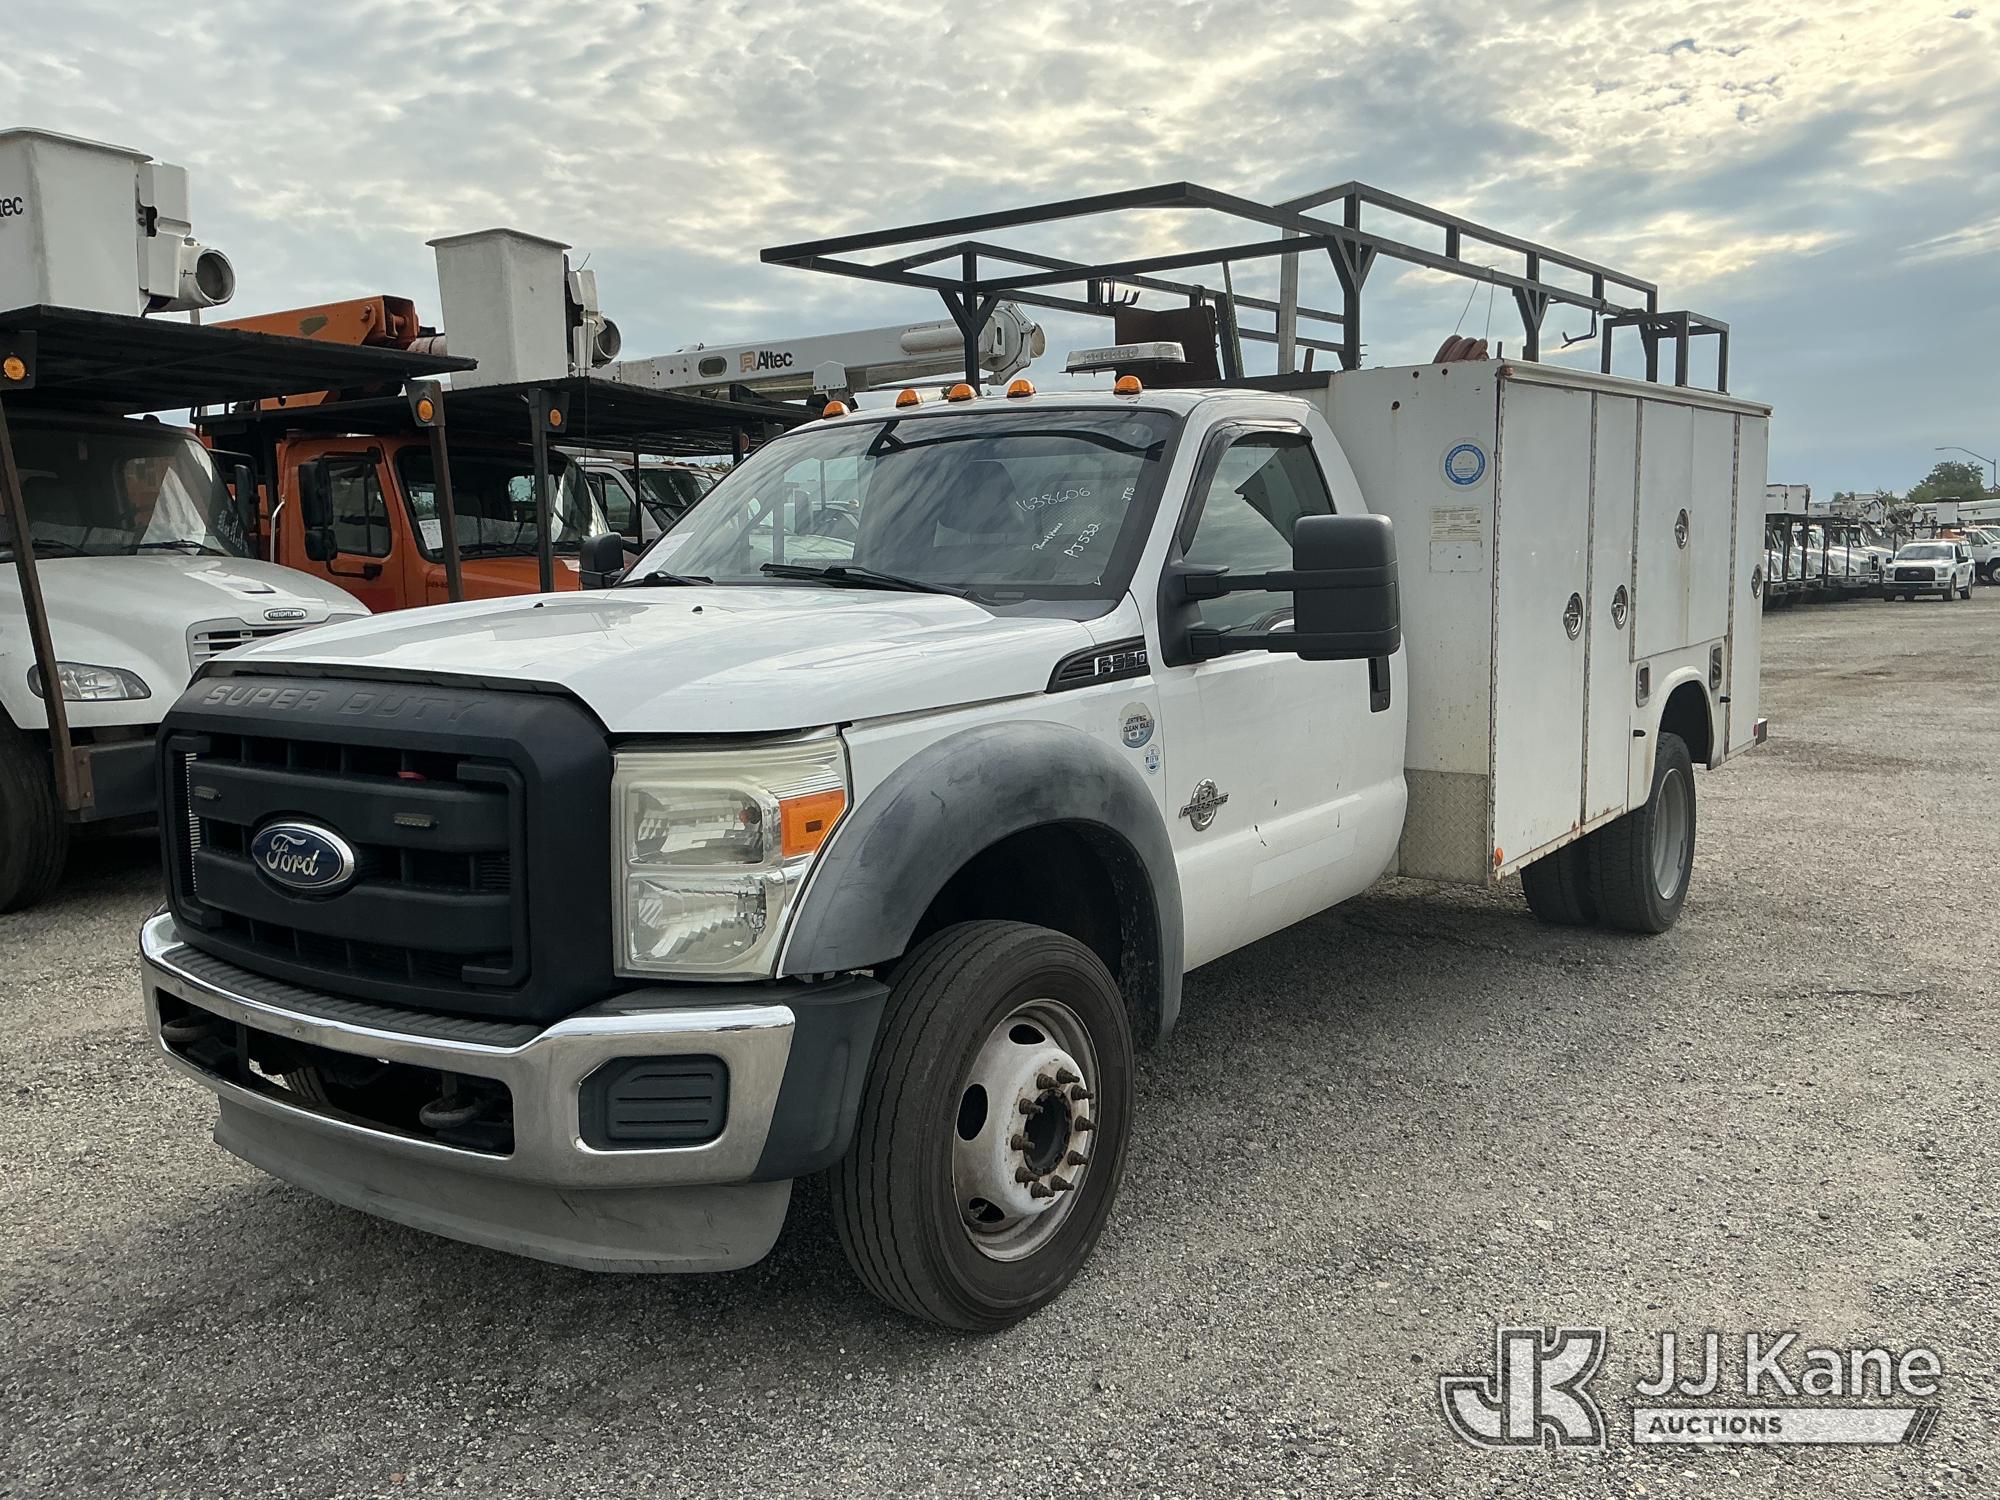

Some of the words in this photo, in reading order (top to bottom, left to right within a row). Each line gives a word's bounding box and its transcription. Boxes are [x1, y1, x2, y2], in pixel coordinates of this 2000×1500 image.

[756, 350, 794, 370] Altec
[1015, 487, 1091, 512] 1638606
[202, 684, 330, 713] SUPER
[337, 692, 488, 722] DUTY
[266, 833, 320, 877] Ford
